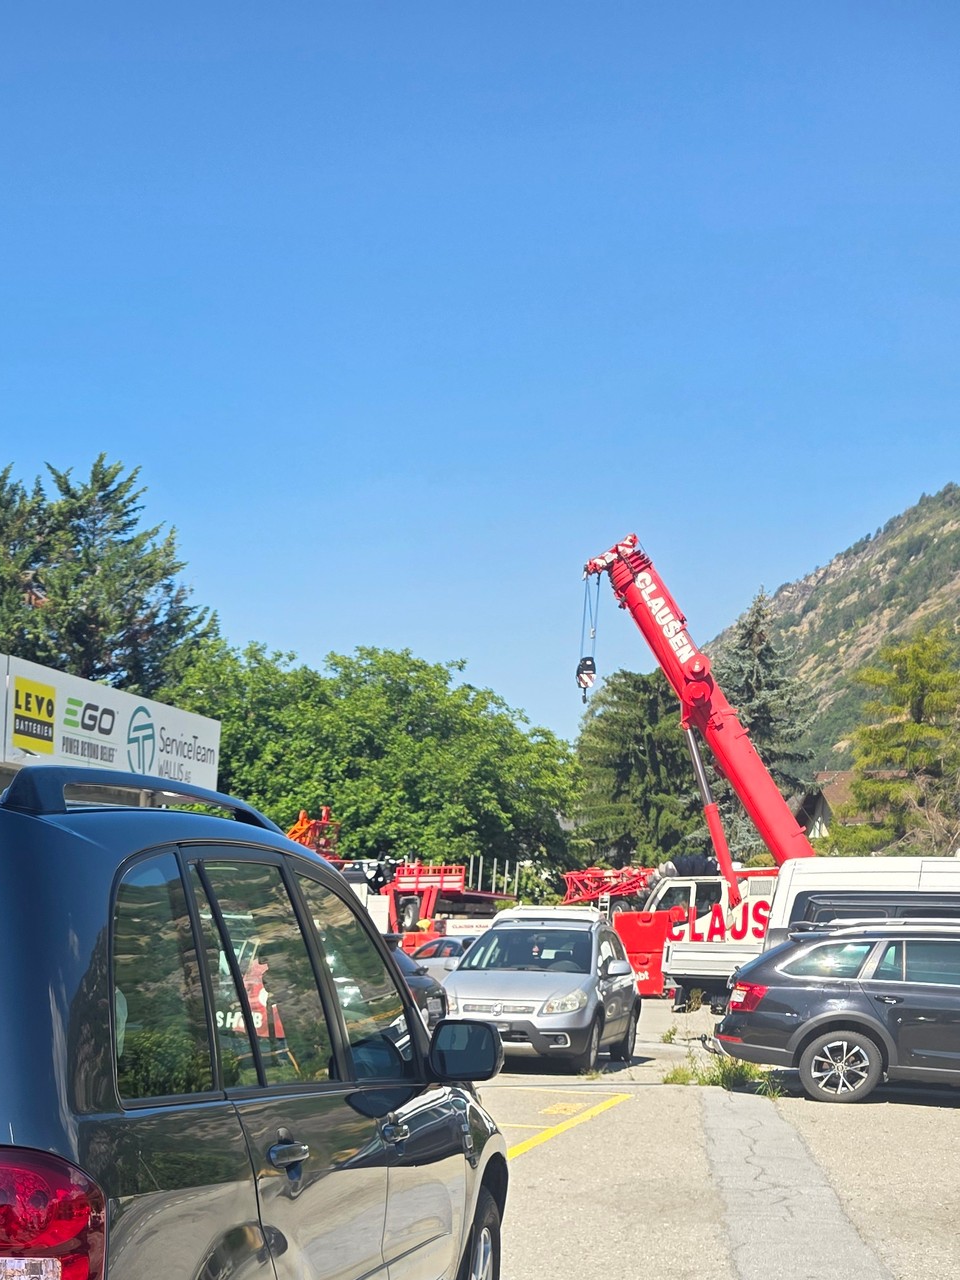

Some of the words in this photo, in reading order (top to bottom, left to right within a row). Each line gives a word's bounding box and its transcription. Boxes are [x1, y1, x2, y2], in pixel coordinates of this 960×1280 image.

[635, 572, 695, 664] CLAUSEN
[15, 689, 55, 718] LEVO
[63, 697, 115, 736] EGO
[15, 718, 53, 738] BATTERIEN
[61, 736, 79, 755] POWER
[159, 726, 216, 766] ServiceTeam
[158, 757, 184, 781] WALLIS
